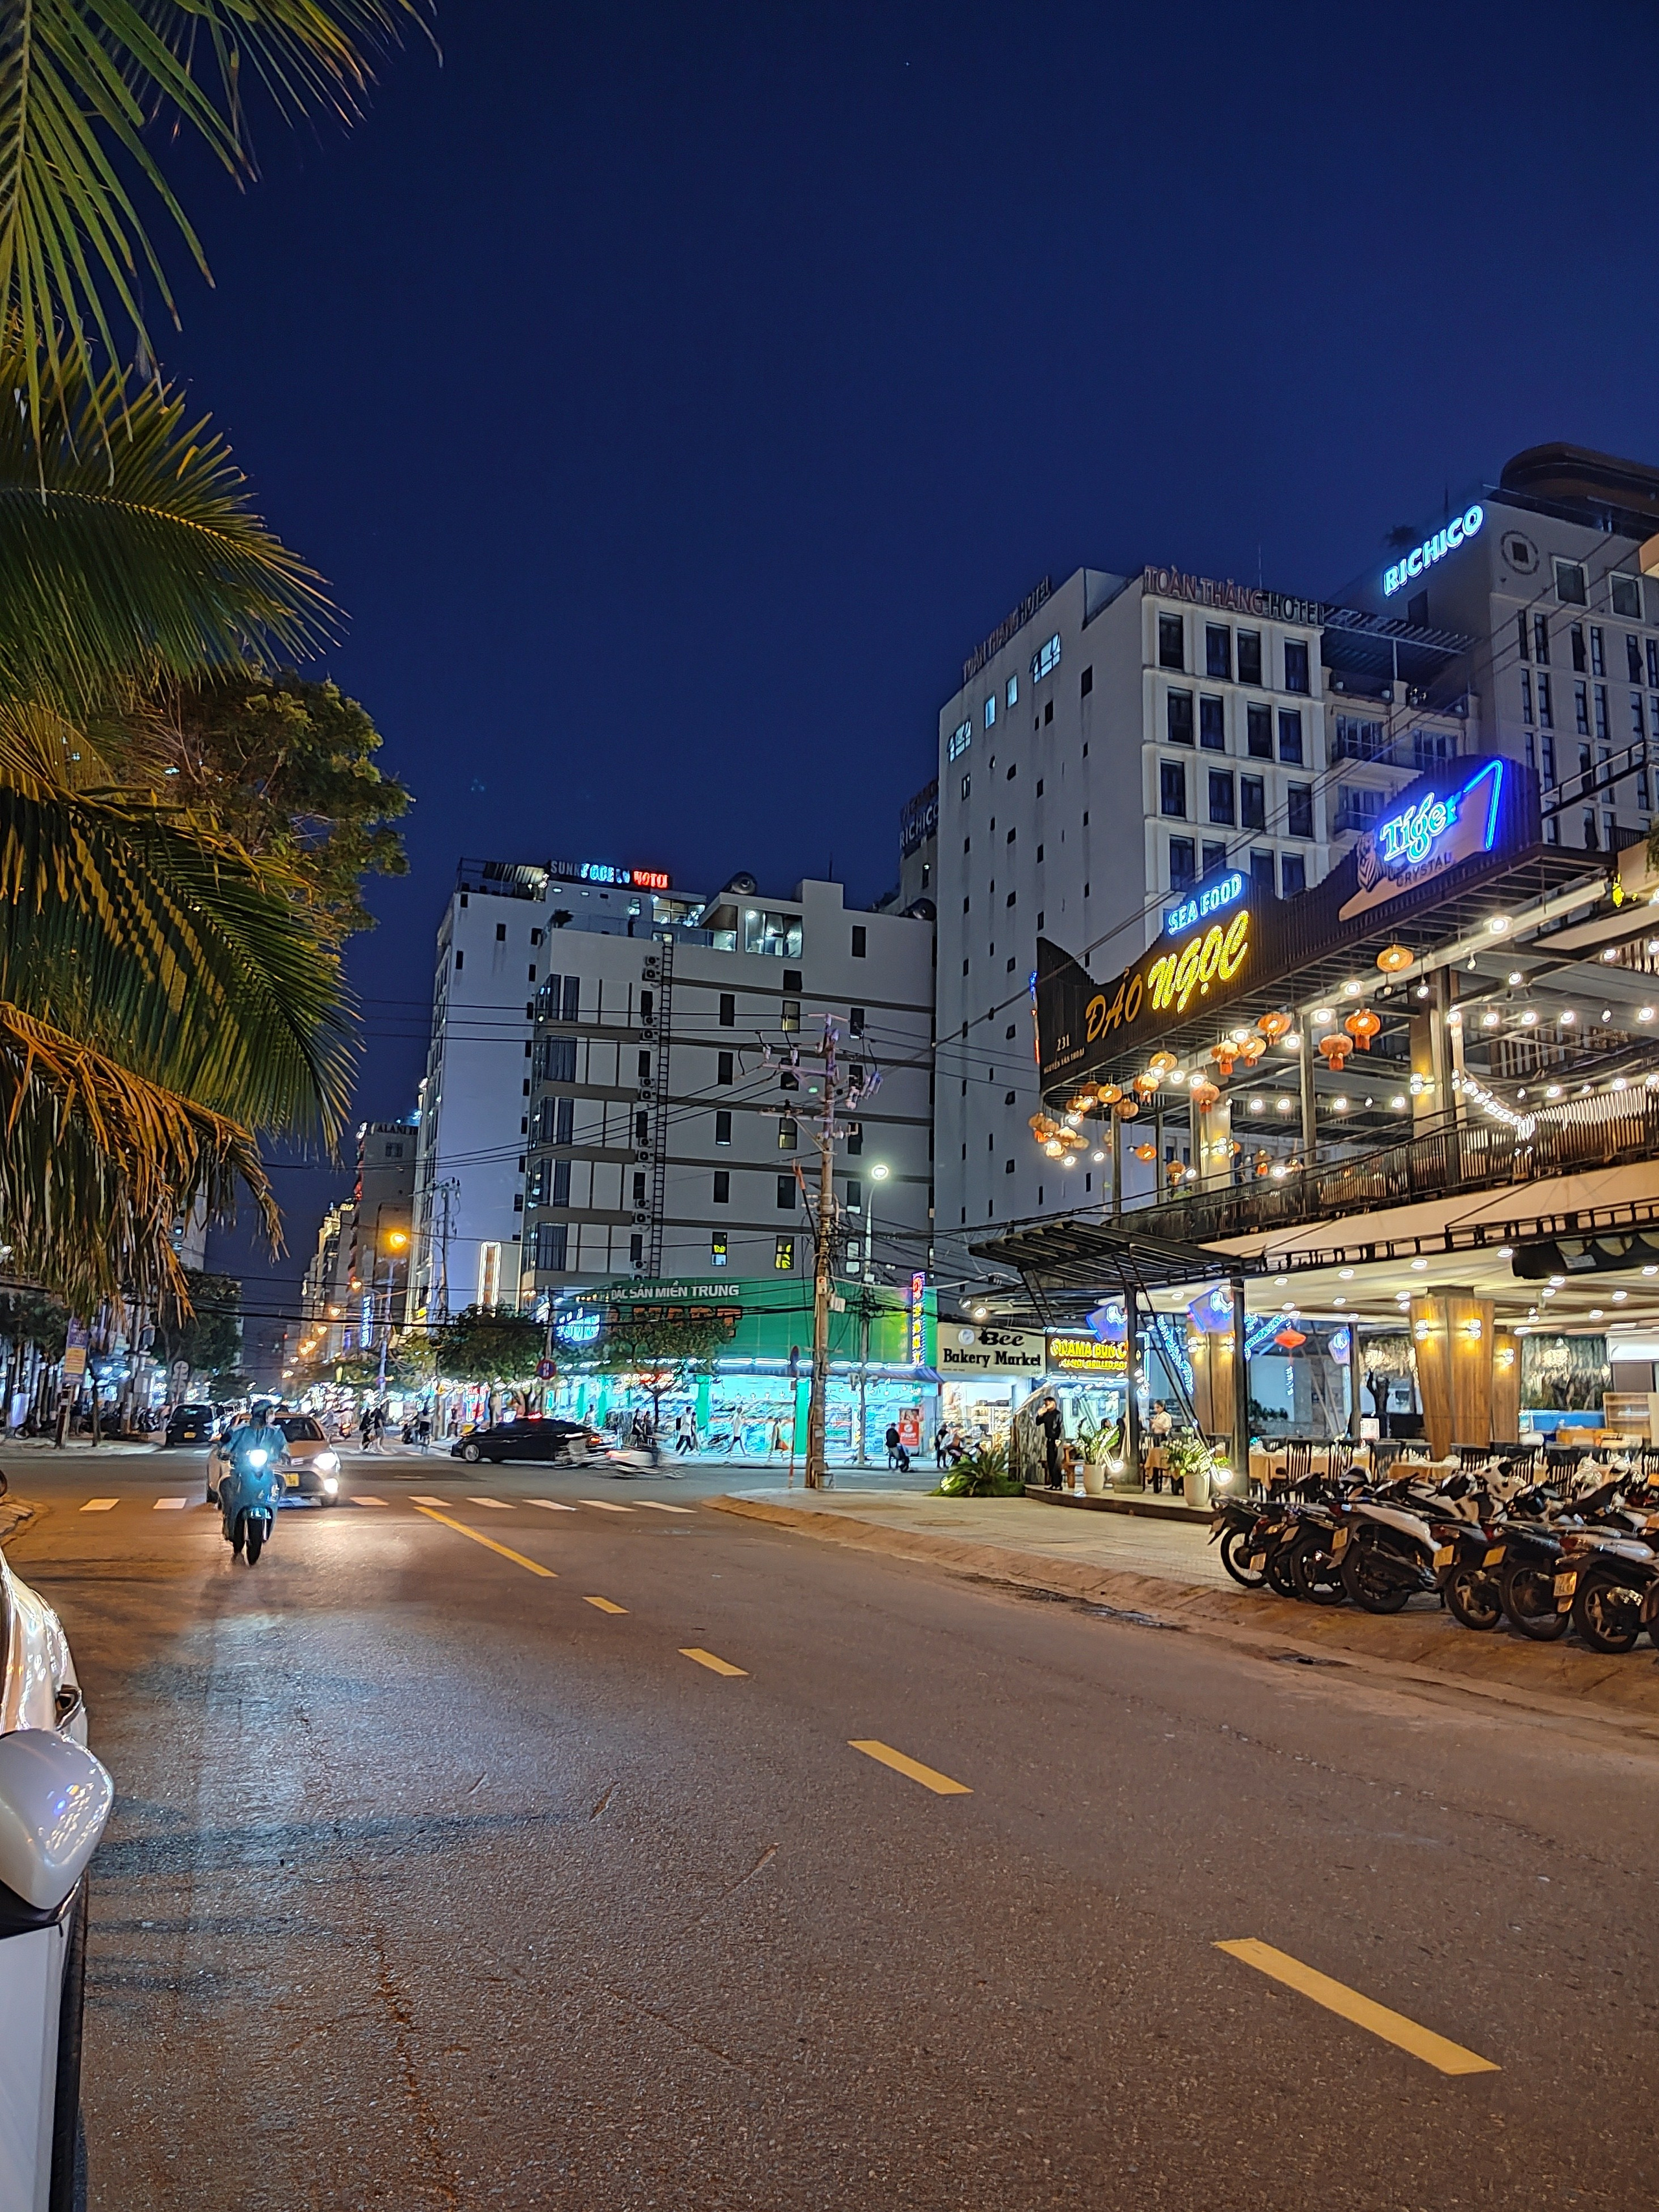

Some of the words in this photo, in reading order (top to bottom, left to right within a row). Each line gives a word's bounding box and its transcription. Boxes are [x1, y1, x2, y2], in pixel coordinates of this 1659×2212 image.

[1384, 505, 1483, 596] RICHICO
[1144, 565, 1197, 601] TOÀN
[1269, 592, 1326, 628] HOTEL
[1396, 852, 1453, 887] CRYSTAL
[1168, 900, 1198, 935] SEA
[1200, 874, 1242, 917] FOOD
[1056, 1032, 1070, 1051] 231
[690, 1285, 739, 1297] TRUNG
[978, 1327, 1025, 1346] Bee
[944, 1348, 991, 1368] Bakery
[995, 1350, 1041, 1366] Market
